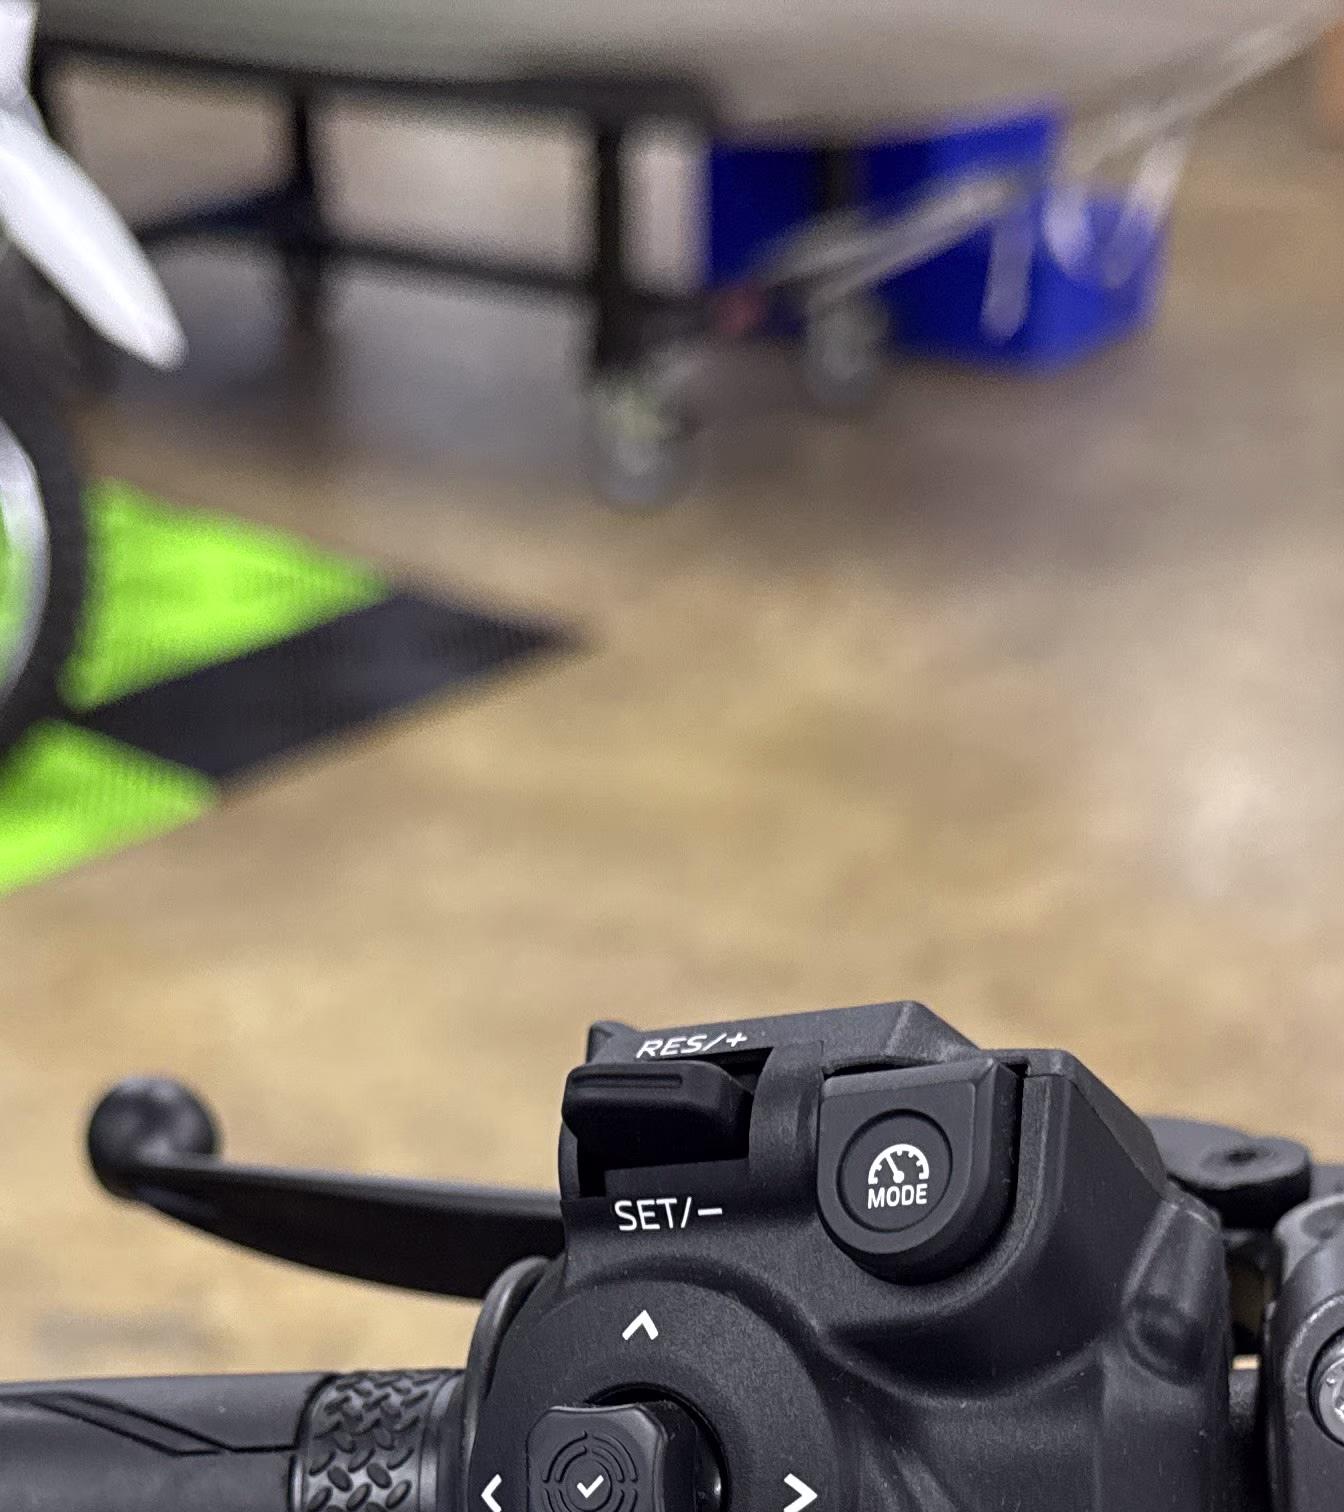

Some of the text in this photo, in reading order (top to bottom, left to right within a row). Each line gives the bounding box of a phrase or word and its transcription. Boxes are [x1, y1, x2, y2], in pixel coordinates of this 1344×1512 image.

[635, 1030, 749, 1059] RES/+
[866, 1183, 929, 1210] MODE
[613, 1196, 723, 1232] SET/-
